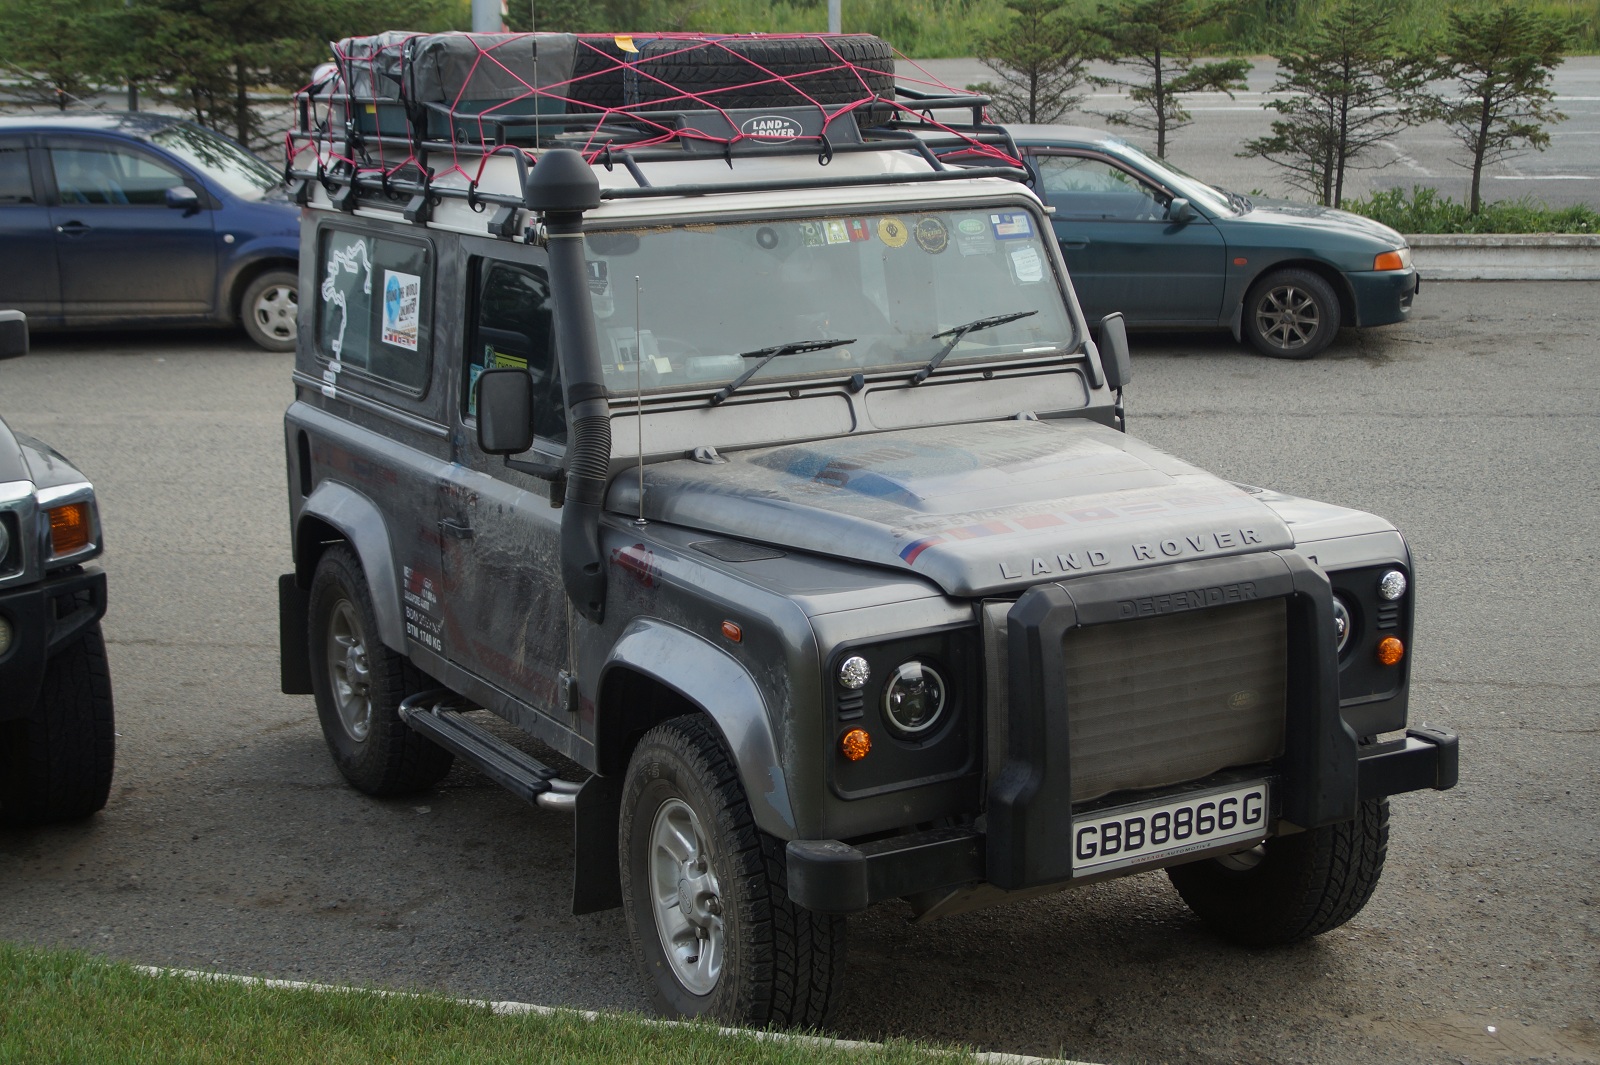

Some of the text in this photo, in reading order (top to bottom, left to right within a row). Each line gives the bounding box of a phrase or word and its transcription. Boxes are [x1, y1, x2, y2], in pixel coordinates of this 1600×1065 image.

[753, 120, 782, 129] LAND
[406, 282, 418, 296] WORLD
[999, 527, 1263, 579] LAND ROVER
[1117, 581, 1259, 617] DEFENDER
[406, 621, 419, 639] BTM
[432, 636, 442, 652] KG
[1076, 791, 1262, 860] GBB8866G
